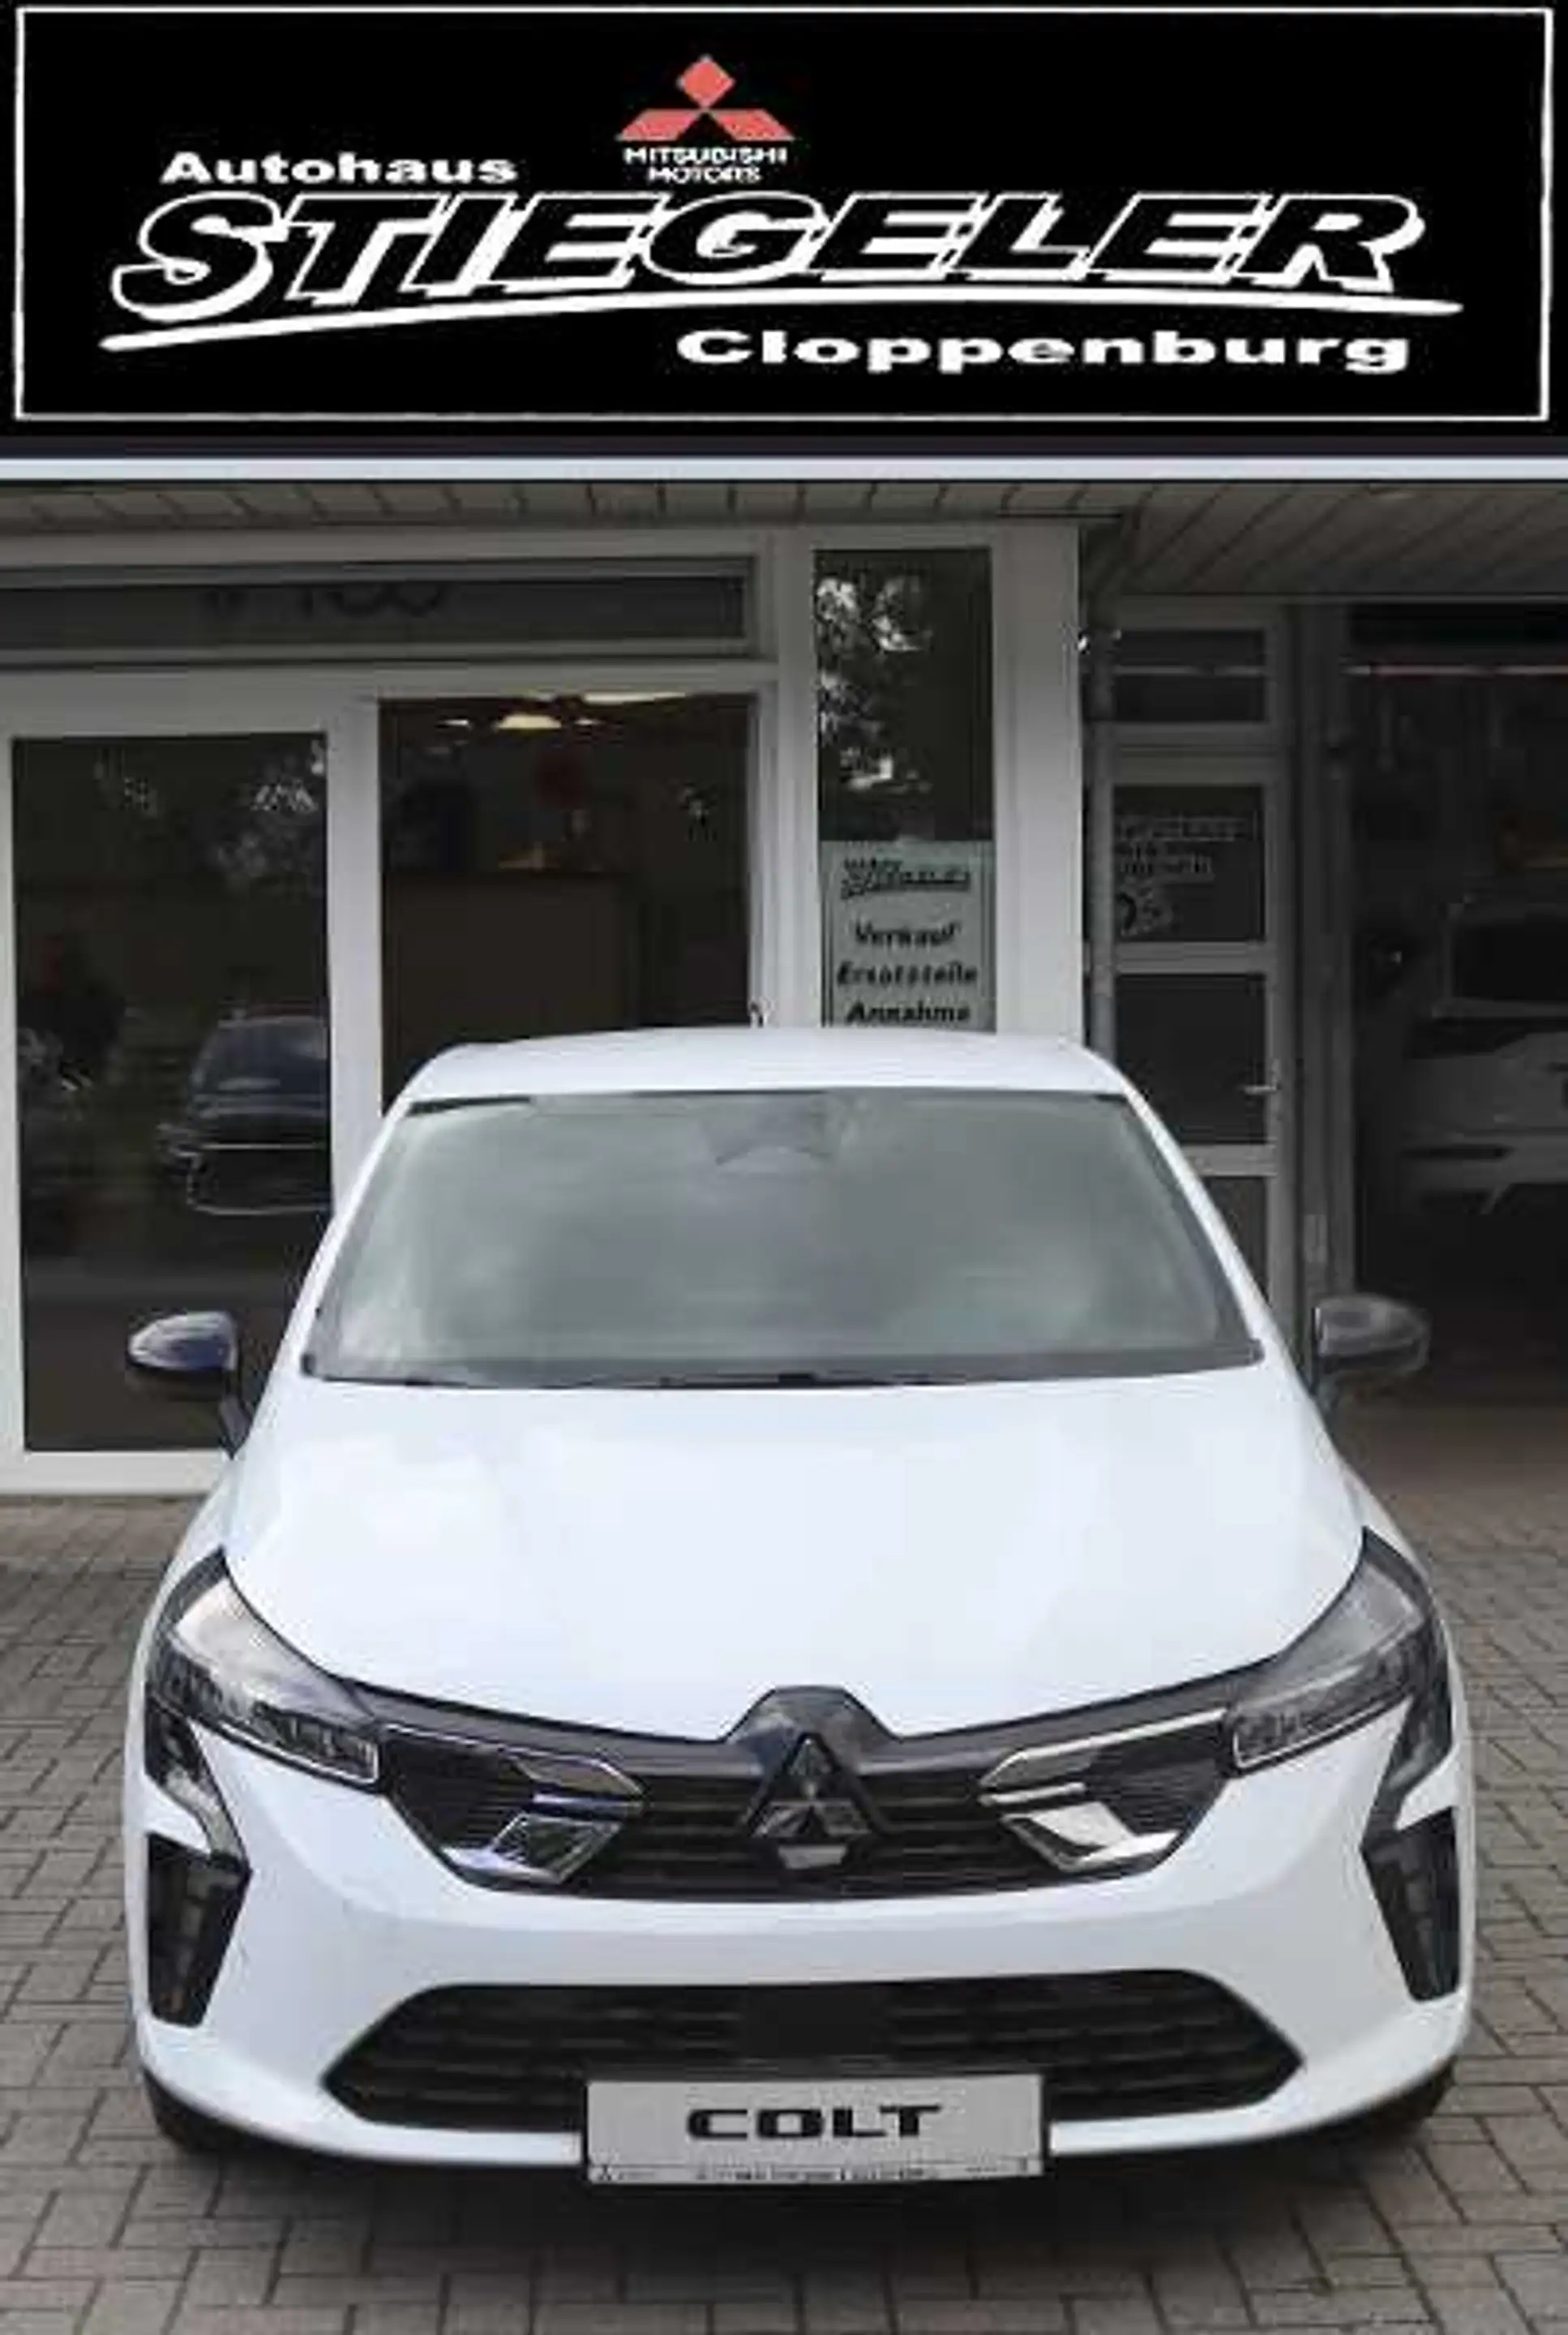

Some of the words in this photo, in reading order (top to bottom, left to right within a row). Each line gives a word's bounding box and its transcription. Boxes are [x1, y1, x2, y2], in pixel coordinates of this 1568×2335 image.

[161, 152, 518, 185] Autohaus
[623, 146, 788, 165] MITSUBISHI
[648, 166, 762, 185] MOTORS
[111, 191, 1426, 323] STIEGELER
[676, 329, 1409, 375] Cloppenburg
[687, 2104, 942, 2140] COLT
